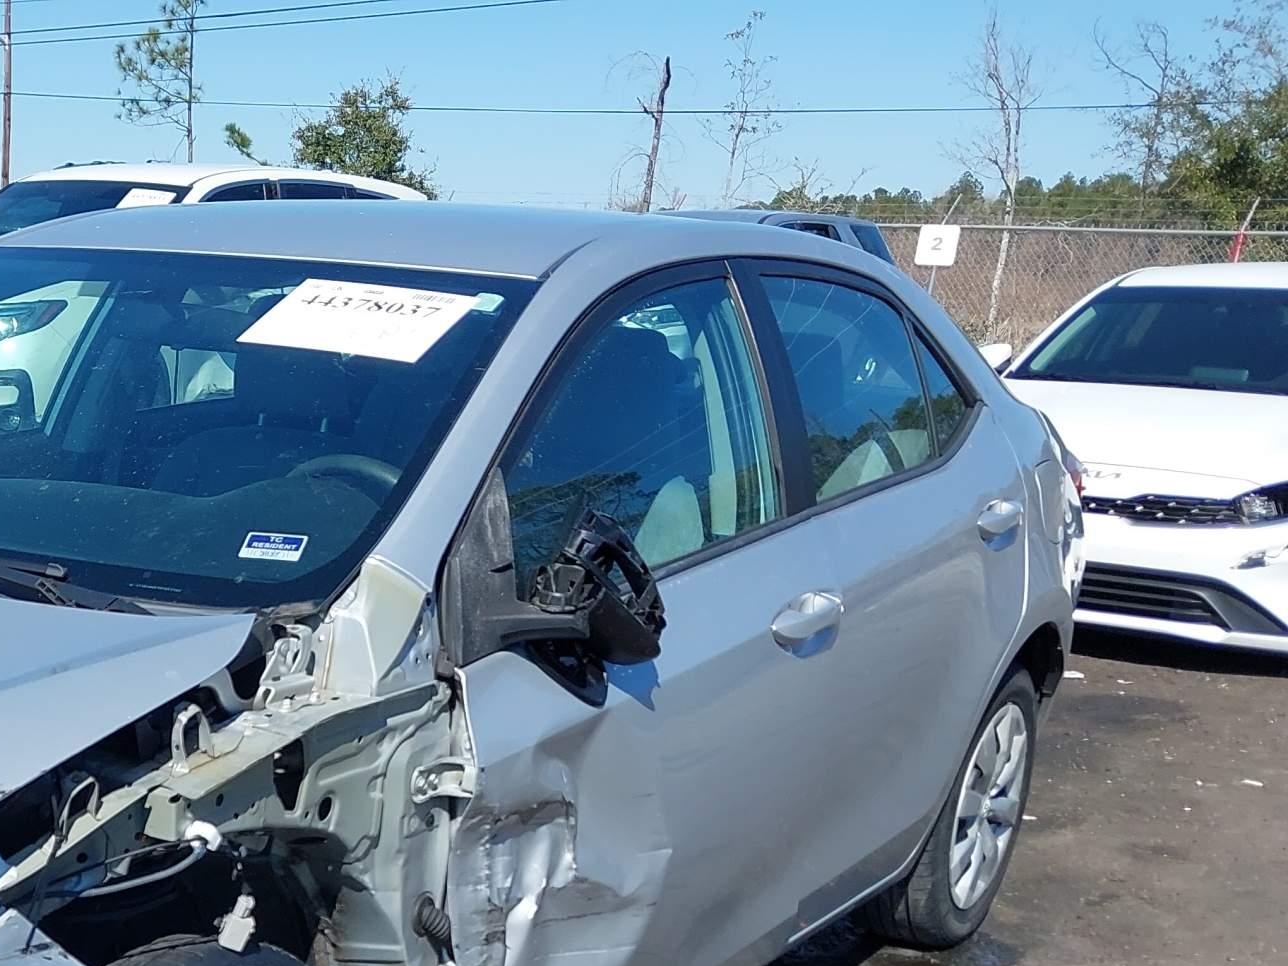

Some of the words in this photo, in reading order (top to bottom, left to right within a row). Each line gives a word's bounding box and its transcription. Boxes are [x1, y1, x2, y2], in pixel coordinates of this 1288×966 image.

[930, 237, 943, 251] 2
[301, 294, 442, 318] 44378037
[251, 541, 298, 551] RESIDENT
